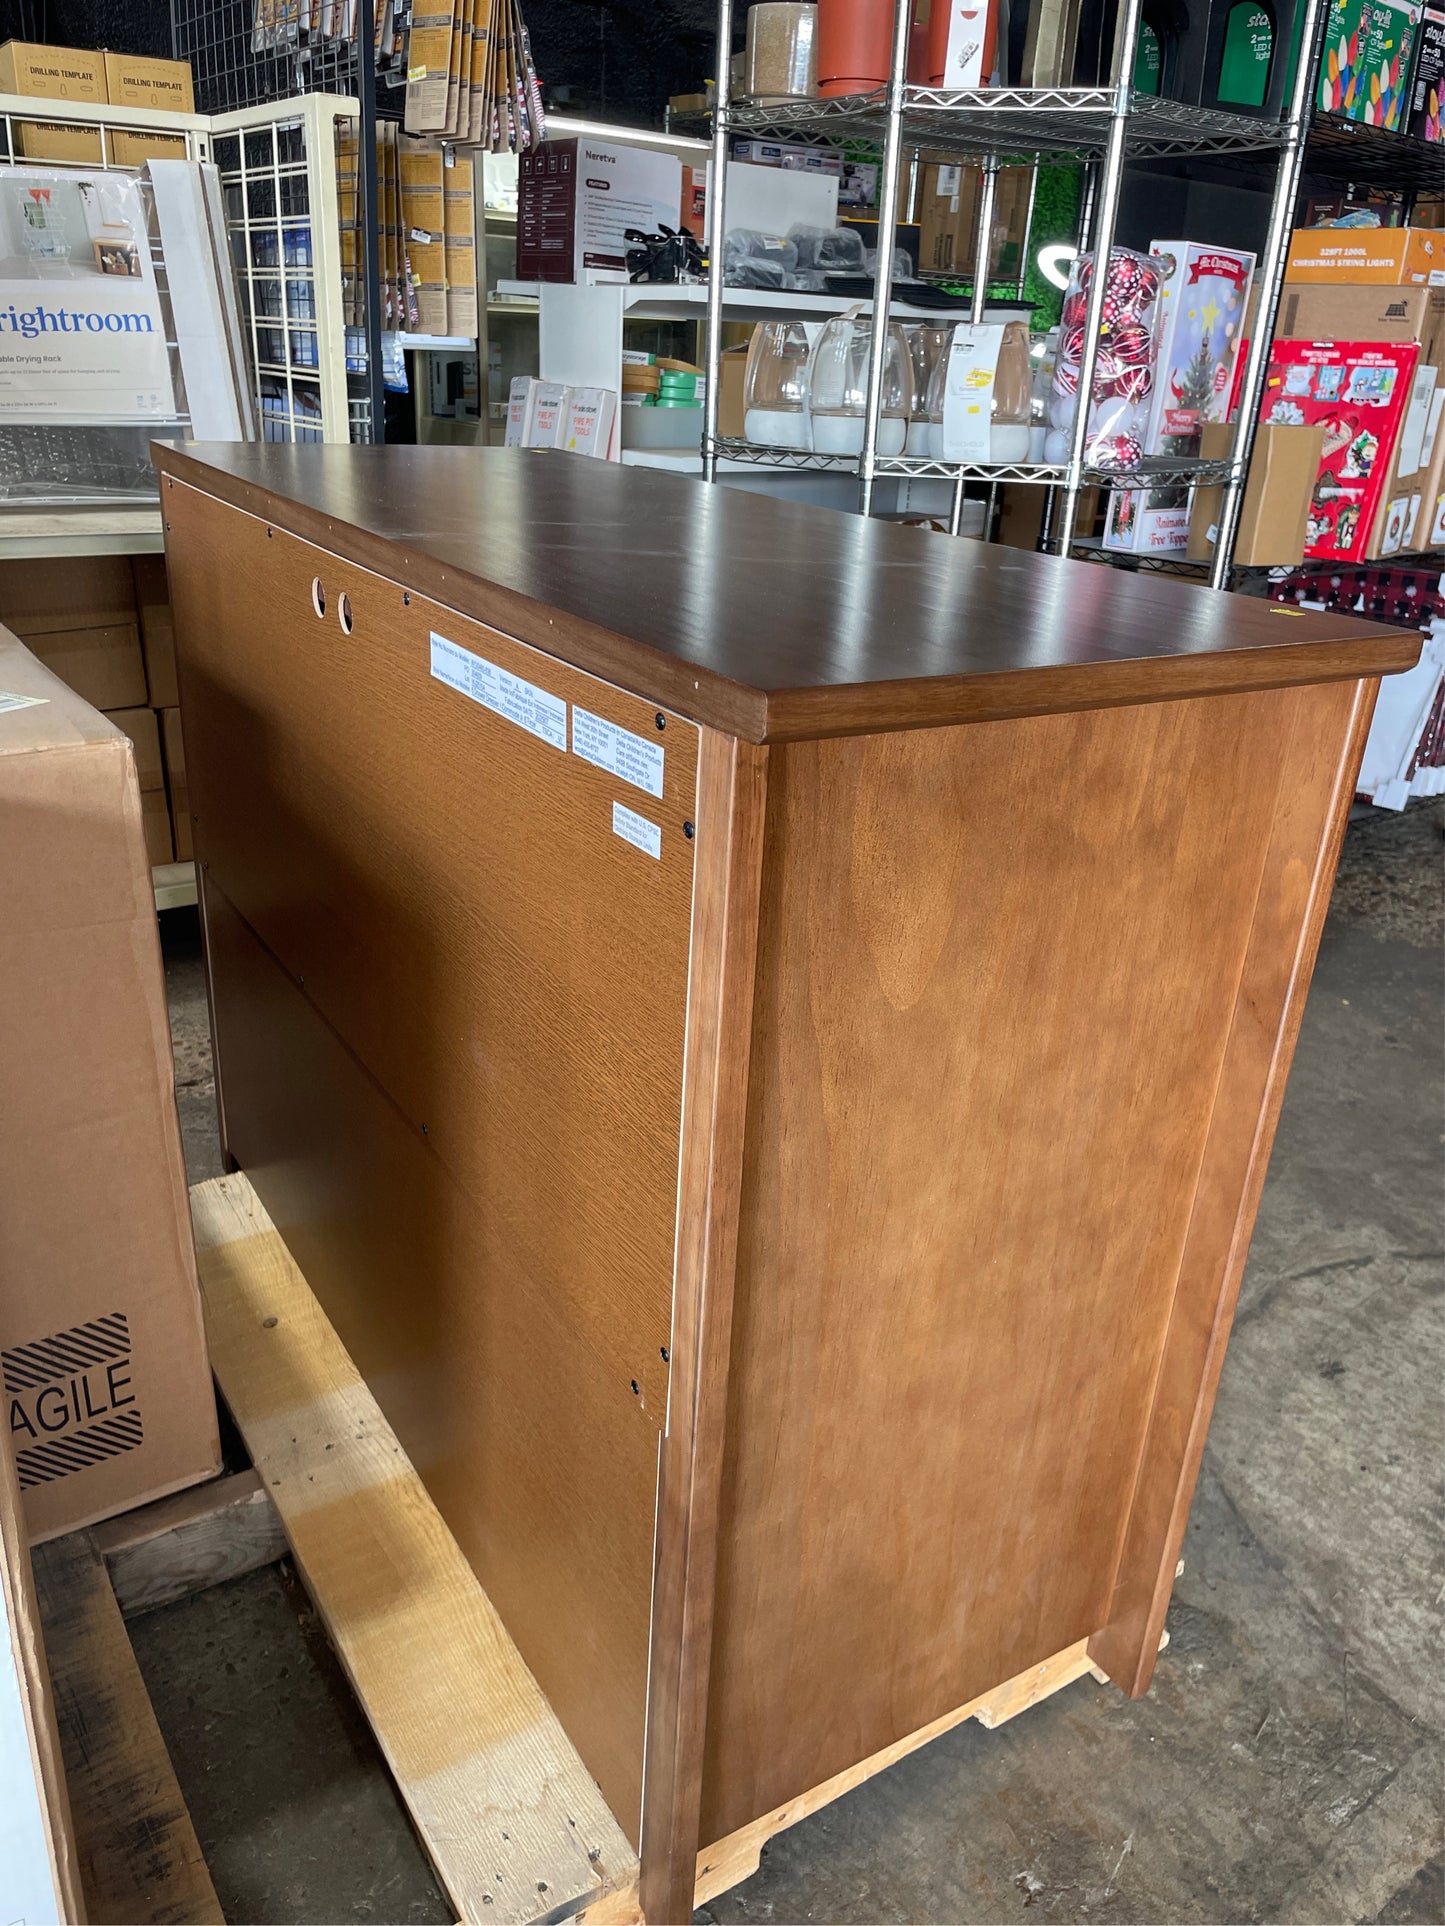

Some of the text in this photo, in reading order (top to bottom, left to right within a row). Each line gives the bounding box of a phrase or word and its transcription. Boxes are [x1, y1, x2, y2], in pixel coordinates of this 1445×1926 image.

[1250, 34, 1257, 44] 2
[1254, 43, 1267, 52] LED
[1422, 44, 1428, 54] 2
[30, 66, 94, 81] DRILLING TEMPLATE
[123, 77, 183, 91] DRILLING TEMPLATE
[36, 123, 66, 132] DRILLING
[586, 150, 616, 164] Neretva
[1292, 259, 1395, 267] CHRISTMAS STRING LIGHTS
[16, 355, 42, 364] Drying
[538, 411, 547, 419] FIRE
[1171, 411, 1193, 423] Merry
[538, 421, 552, 430] TOOLS
[574, 417, 595, 426] FIRE PIT
[575, 427, 591, 436] TOOLS
[1164, 423, 1194, 433] Christmas
[10, 1359, 135, 1437] AGILE
